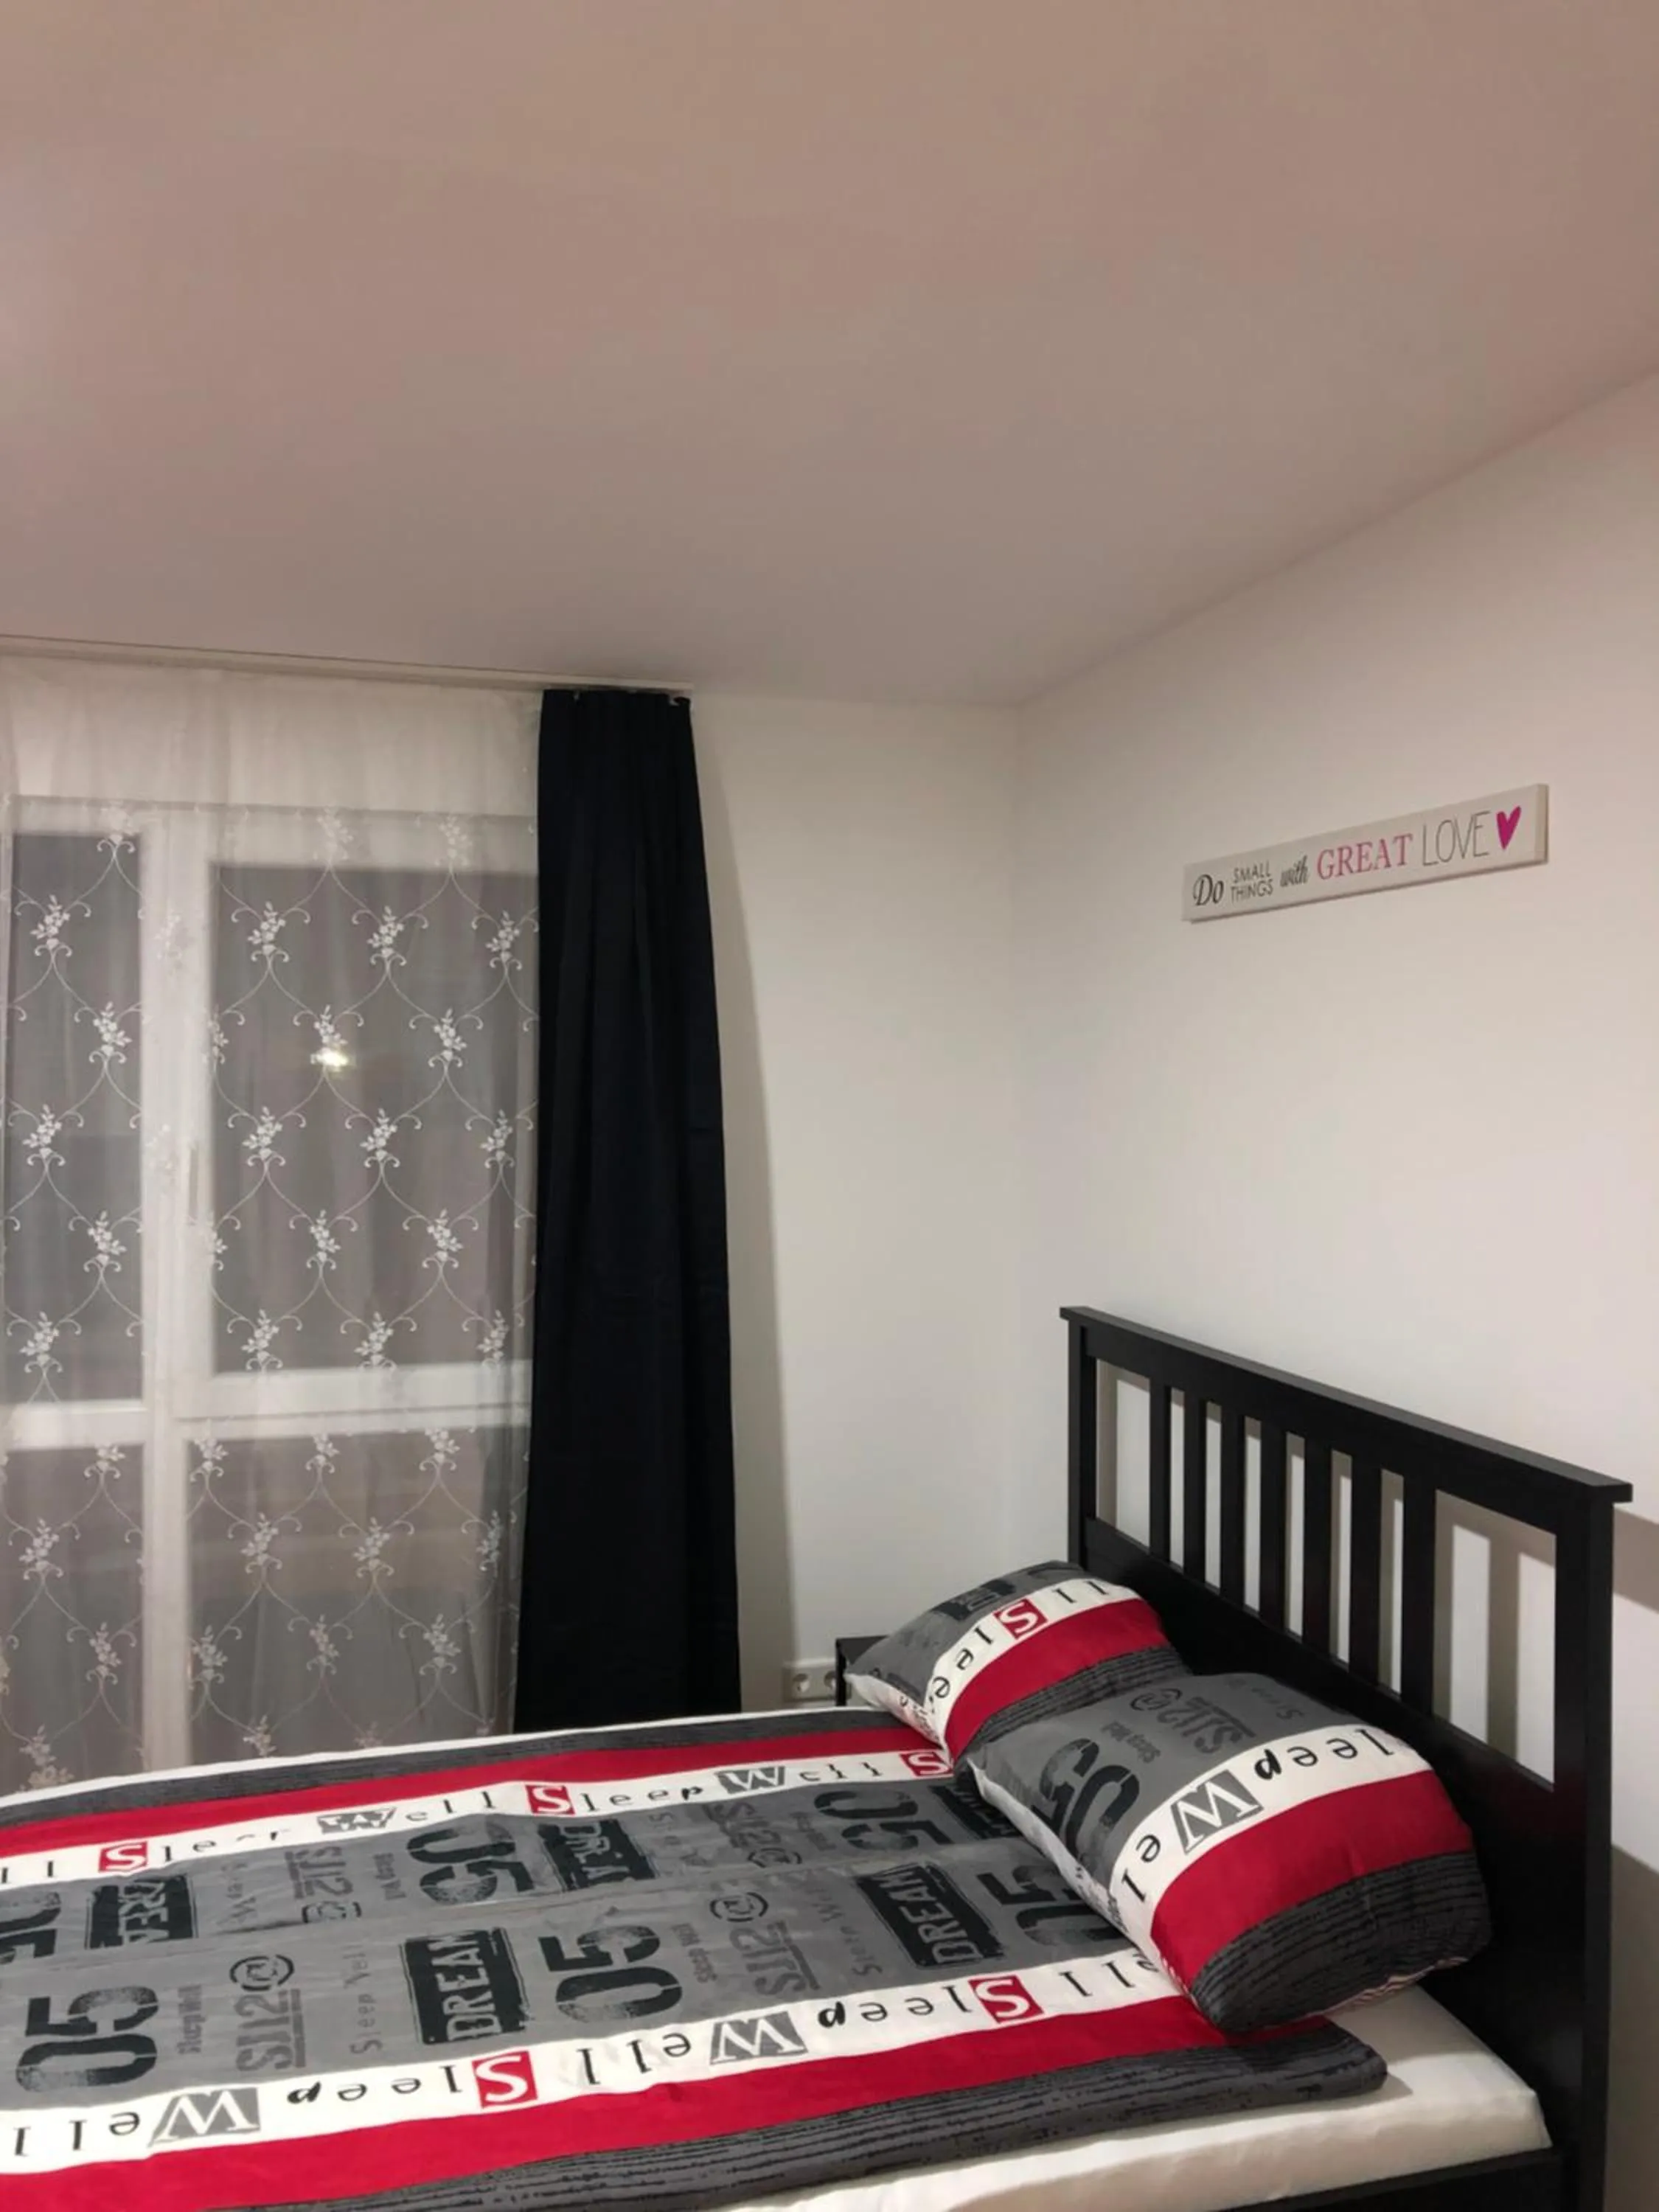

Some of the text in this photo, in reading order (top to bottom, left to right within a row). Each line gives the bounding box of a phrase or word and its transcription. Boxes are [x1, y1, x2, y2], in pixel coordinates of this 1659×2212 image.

[1193, 810, 1492, 906] Do SMALL THINGS with GREAT LOVE
[929, 1598, 1046, 1713] Slee
[526, 1784, 703, 1815] Sleep
[714, 1761, 885, 1794] Well
[1253, 1728, 1394, 1781] leep
[407, 1813, 535, 1905] 05
[1121, 1770, 1265, 1904] Wel
[538, 1924, 683, 2024] 05
[818, 1975, 1043, 2028] Sleep
[15, 1985, 160, 2093] 05
[287, 2051, 536, 2109] Sleep
[577, 2010, 809, 2085] Well
[13, 2087, 262, 2157] Well
